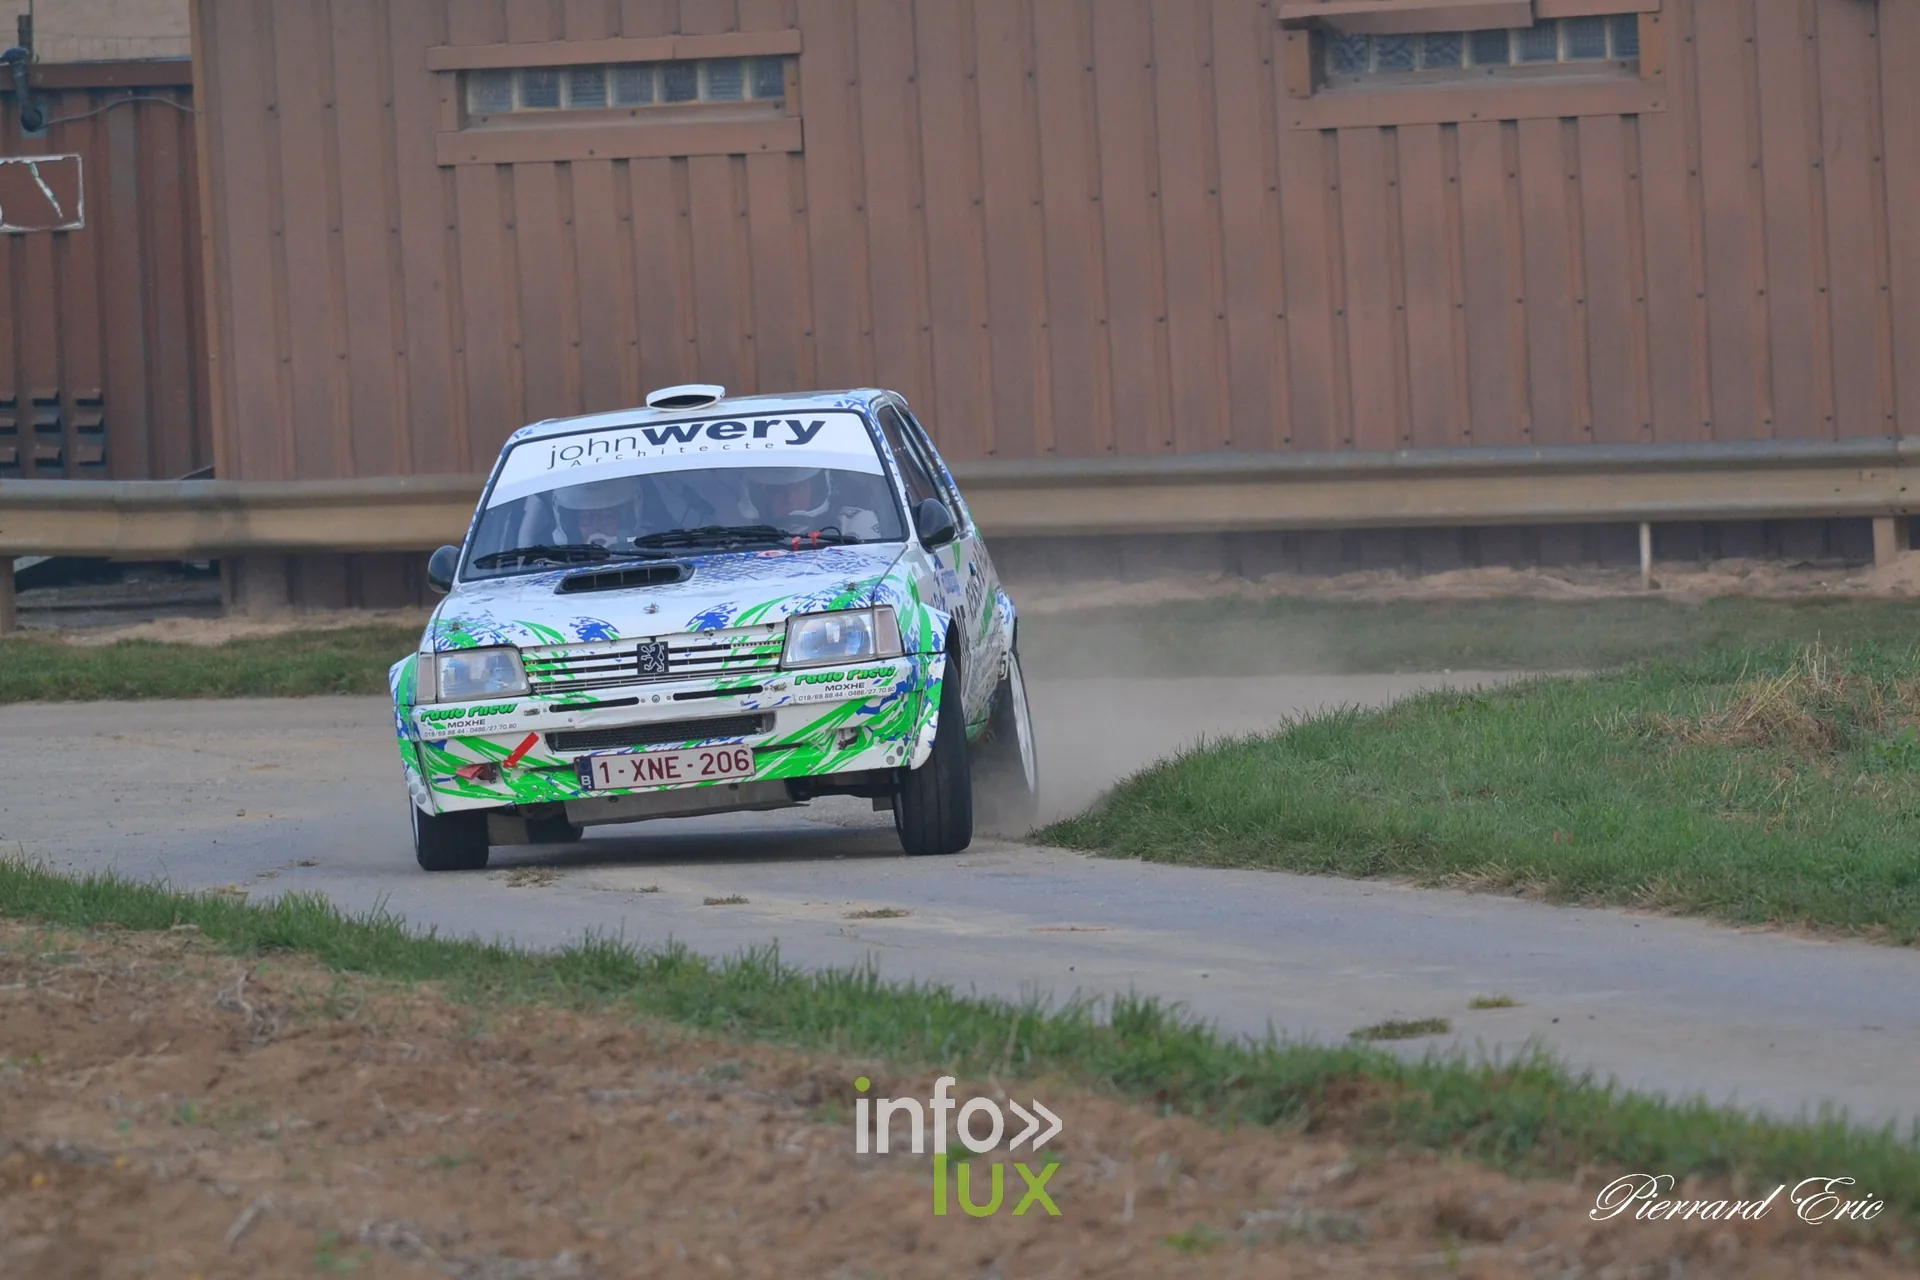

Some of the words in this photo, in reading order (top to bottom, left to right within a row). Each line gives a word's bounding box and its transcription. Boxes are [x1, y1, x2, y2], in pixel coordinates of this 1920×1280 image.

[571, 441, 774, 467] Architecte
[825, 682, 865, 692] MOXHE
[447, 719, 486, 729] MOXHE
